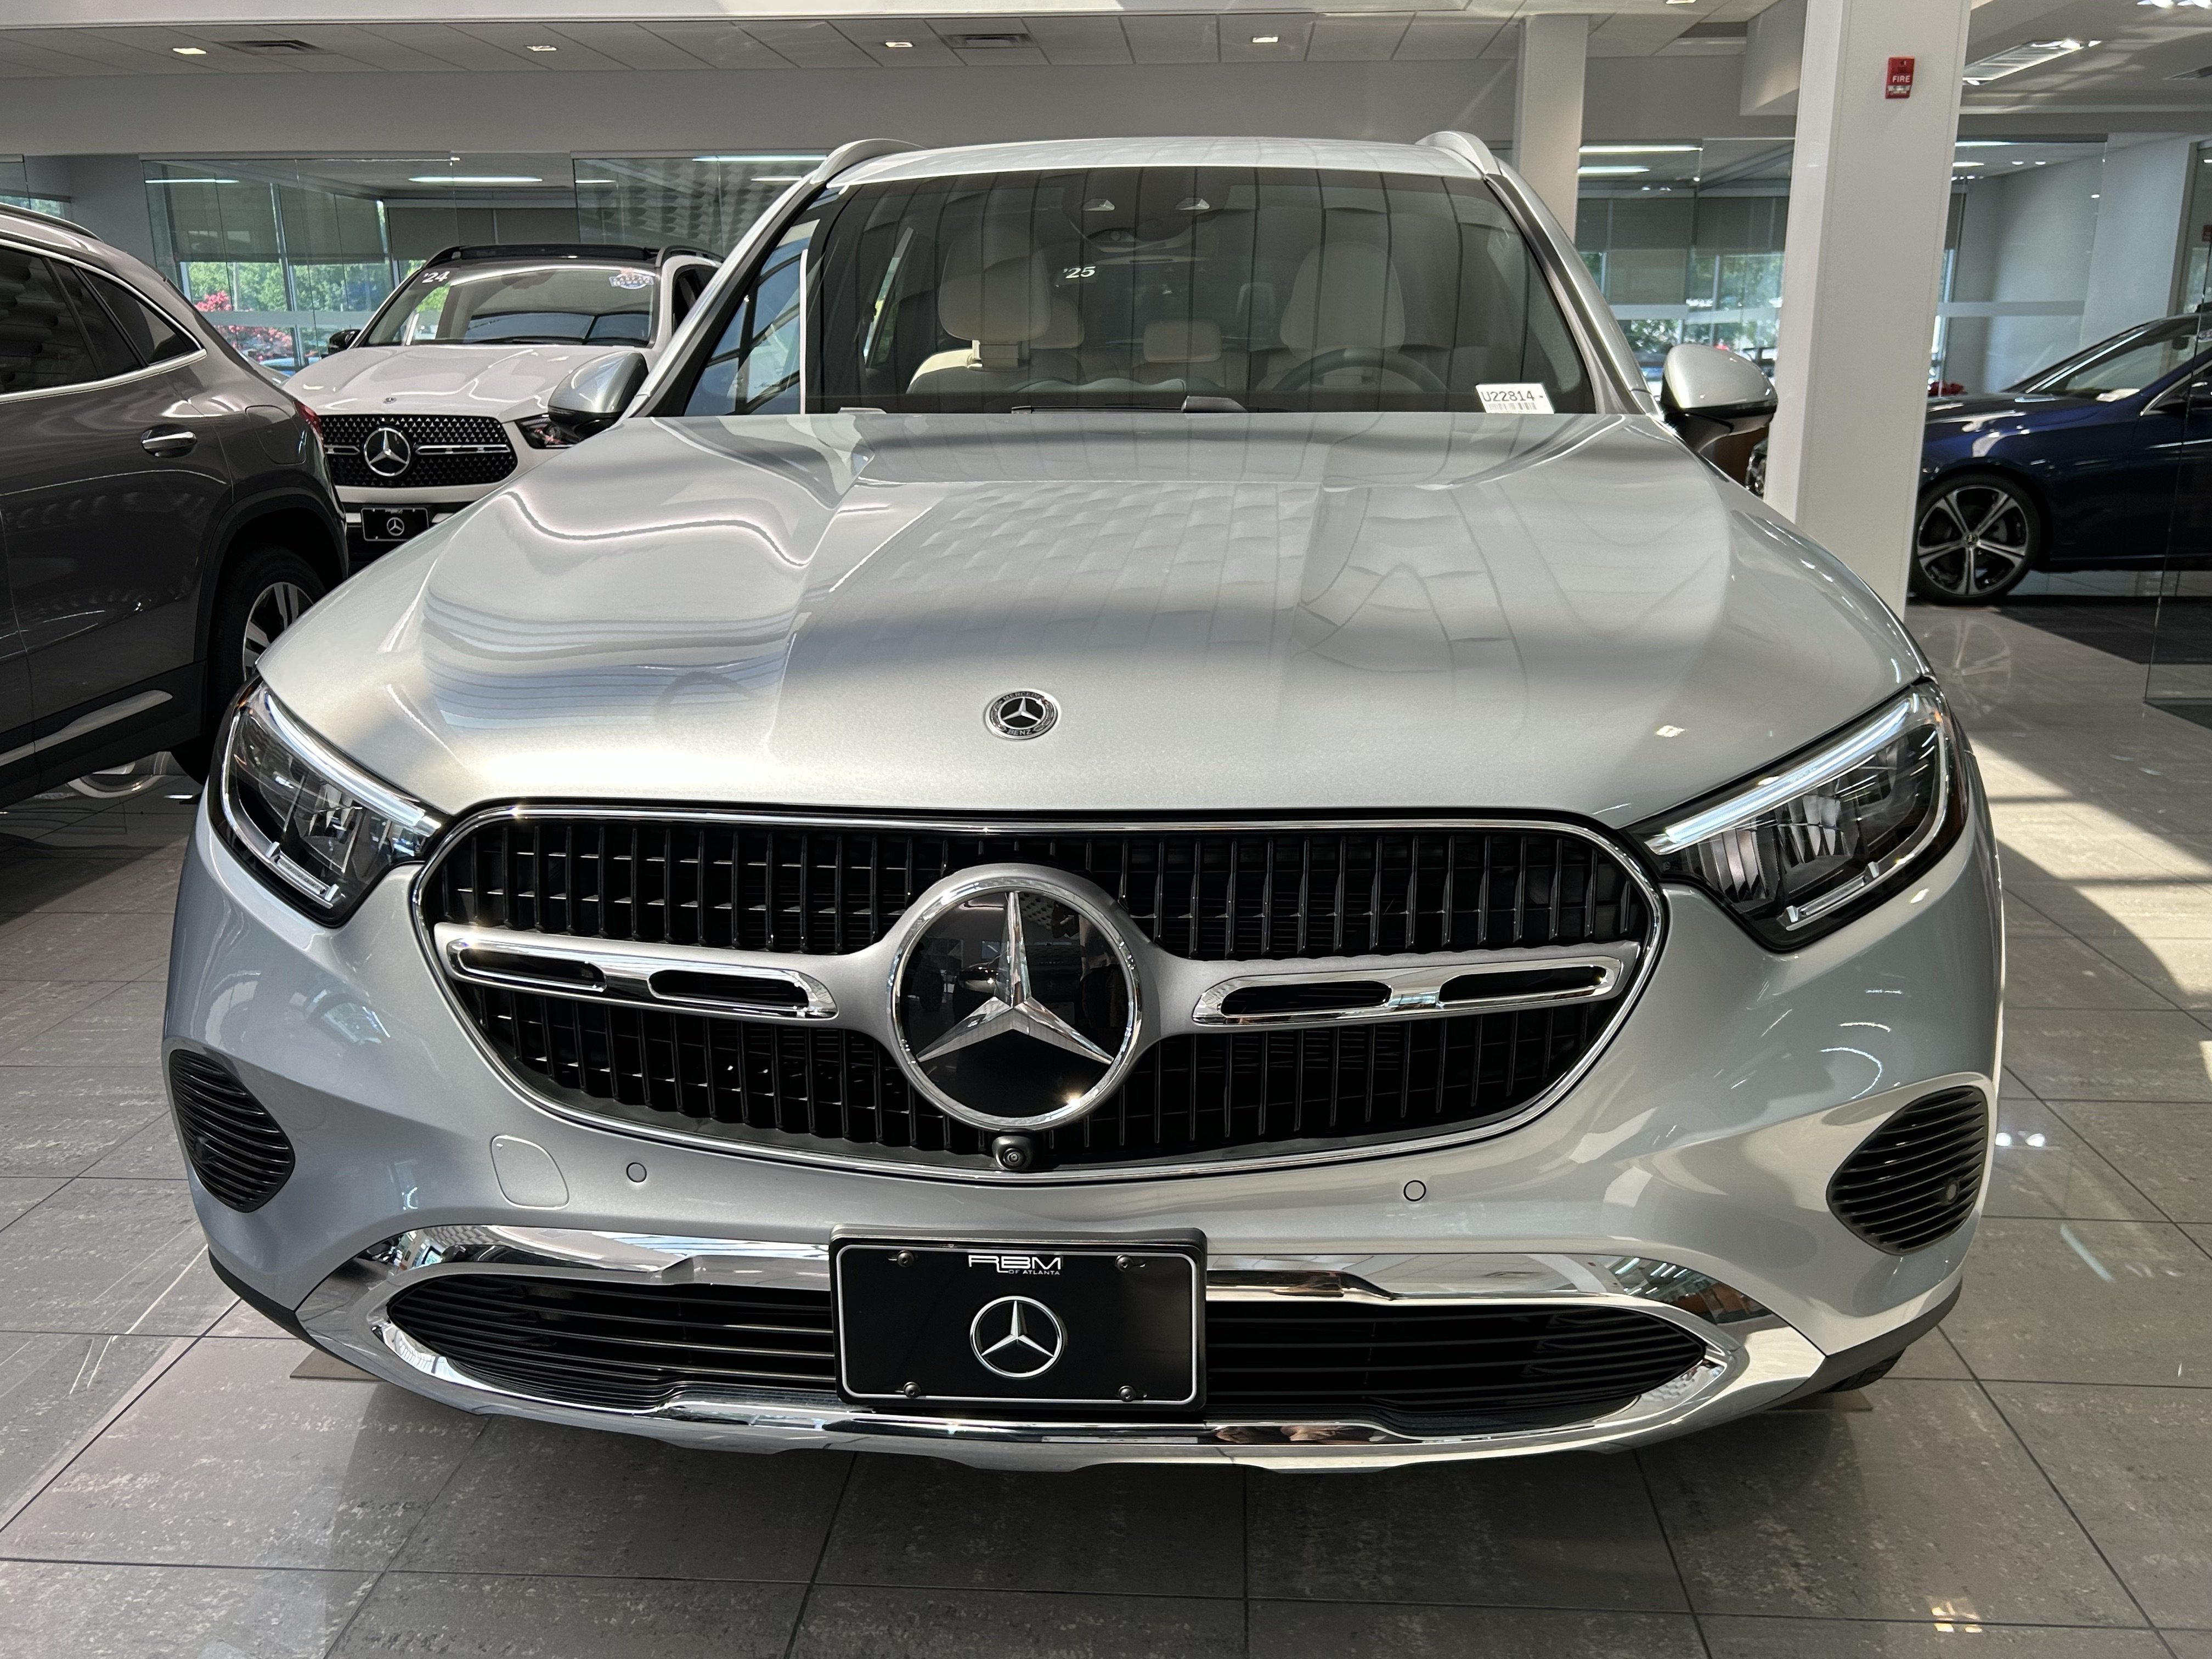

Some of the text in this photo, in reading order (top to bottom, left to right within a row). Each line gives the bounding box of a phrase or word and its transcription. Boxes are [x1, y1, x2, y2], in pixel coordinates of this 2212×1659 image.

[422, 271, 450, 284] '24
[1063, 266, 1096, 279] '25
[1481, 391, 1534, 402] U22814
[968, 1255, 1061, 1273] RBM
